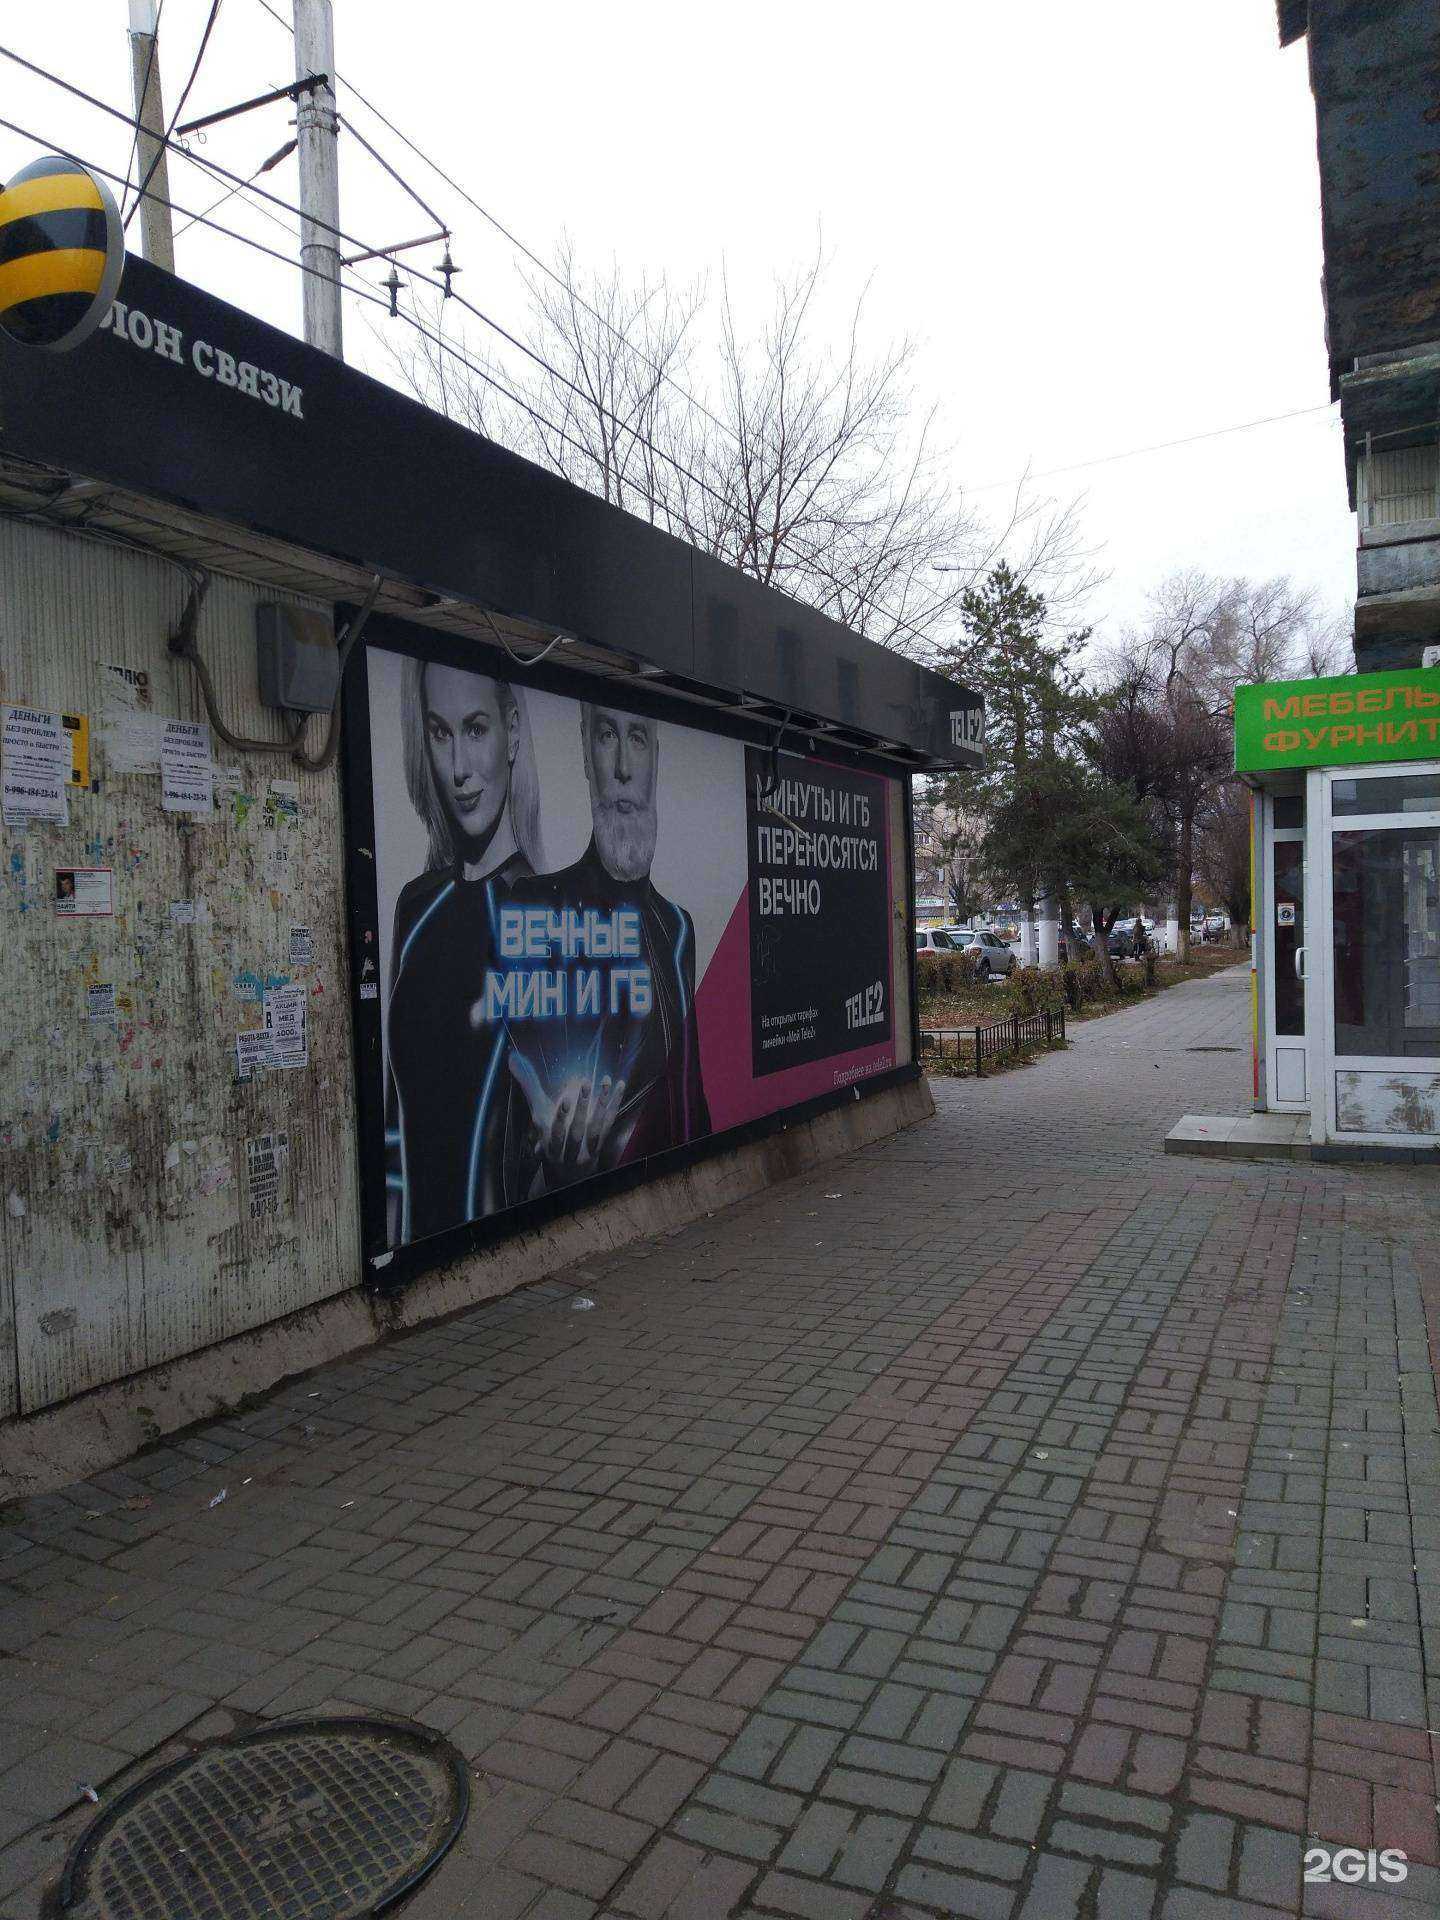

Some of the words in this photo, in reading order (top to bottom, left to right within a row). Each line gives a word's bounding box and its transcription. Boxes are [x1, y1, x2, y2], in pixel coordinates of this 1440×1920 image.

[192, 340, 304, 420] СВЯЗИ
[9, 709, 51, 725] ДЕНЬГИ
[1264, 686, 1440, 720] МЕБЕЛЬ
[2, 737, 29, 747] ПРОСТО
[5, 724, 21, 732] БЕЗ
[21, 727, 57, 738] ПРОБЛЕМ
[165, 723, 200, 736] ДЕНЬГИ
[949, 707, 984, 754] TELE2
[756, 774, 835, 823] МИНУТЫ
[839, 790, 849, 825] И
[853, 794, 870, 827] ГБ
[757, 826, 878, 871] ПЕРЕНОСЯТСЯ
[758, 877, 821, 915] ВЕЧНО
[500, 909, 642, 958] ВЕЧНЫЕ
[486, 970, 569, 1018] МИН
[576, 970, 601, 1015] И
[610, 969, 652, 1015] ГБ
[845, 980, 885, 1029] TELE2
[761, 1014, 770, 1029] На
[771, 1013, 797, 1029] открытых
